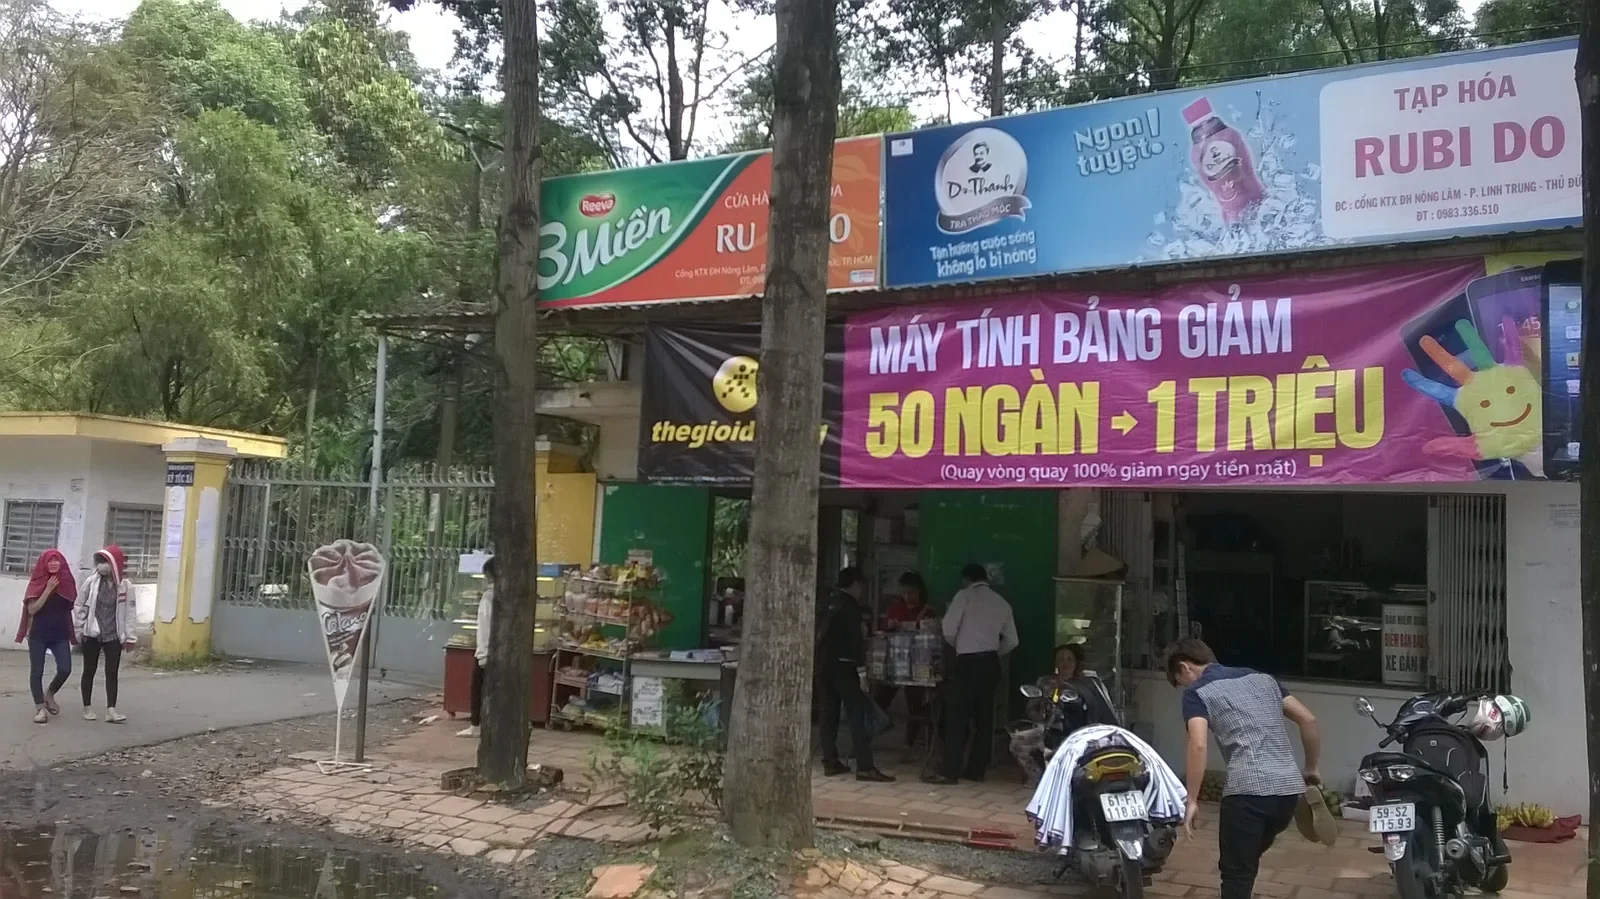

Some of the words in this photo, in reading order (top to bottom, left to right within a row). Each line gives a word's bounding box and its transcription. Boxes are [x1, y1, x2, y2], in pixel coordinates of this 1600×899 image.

[1394, 84, 1448, 114] TẠP
[1458, 71, 1516, 104] HÓA
[1354, 126, 1472, 178] RUBI
[1493, 116, 1566, 163] DO
[724, 191, 750, 210] CỬA
[751, 189, 769, 206] HÀ
[1354, 192, 1378, 210] CỔNG
[1380, 195, 1397, 207] KTX
[1400, 194, 1413, 205] ĐH
[1414, 189, 1439, 204] NÔNG
[1441, 187, 1461, 201] LÂM
[1481, 184, 1503, 197] LINH
[1505, 181, 1537, 195] TRUNG
[1545, 174, 1565, 191] THỦ
[1567, 173, 1583, 189] ĐỨ
[582, 199, 614, 213] Reeva
[1436, 203, 1500, 219] 0983.336.510
[561, 204, 672, 286] Miền
[694, 267, 708, 277] KTX
[869, 315, 944, 375] MÁY
[956, 308, 1040, 371] TÍNH
[1051, 296, 1163, 364] BẢNG
[1177, 284, 1294, 360] GIẢM
[864, 391, 937, 460] 50
[942, 370, 1101, 458] NGÀN
[1146, 380, 1178, 453] 1
[1189, 355, 1386, 468] TRIỆU
[940, 464, 984, 482] (Quay
[986, 464, 1025, 482] vòng
[1028, 466, 1069, 482] quay
[1072, 463, 1117, 478] 100%
[1120, 462, 1163, 481] giảm
[1167, 464, 1210, 481] ngay
[1214, 459, 1249, 477] tiền
[1254, 459, 1297, 479] mặt)
[1385, 654, 1397, 672] XE
[1377, 806, 1408, 819] 59-S2
